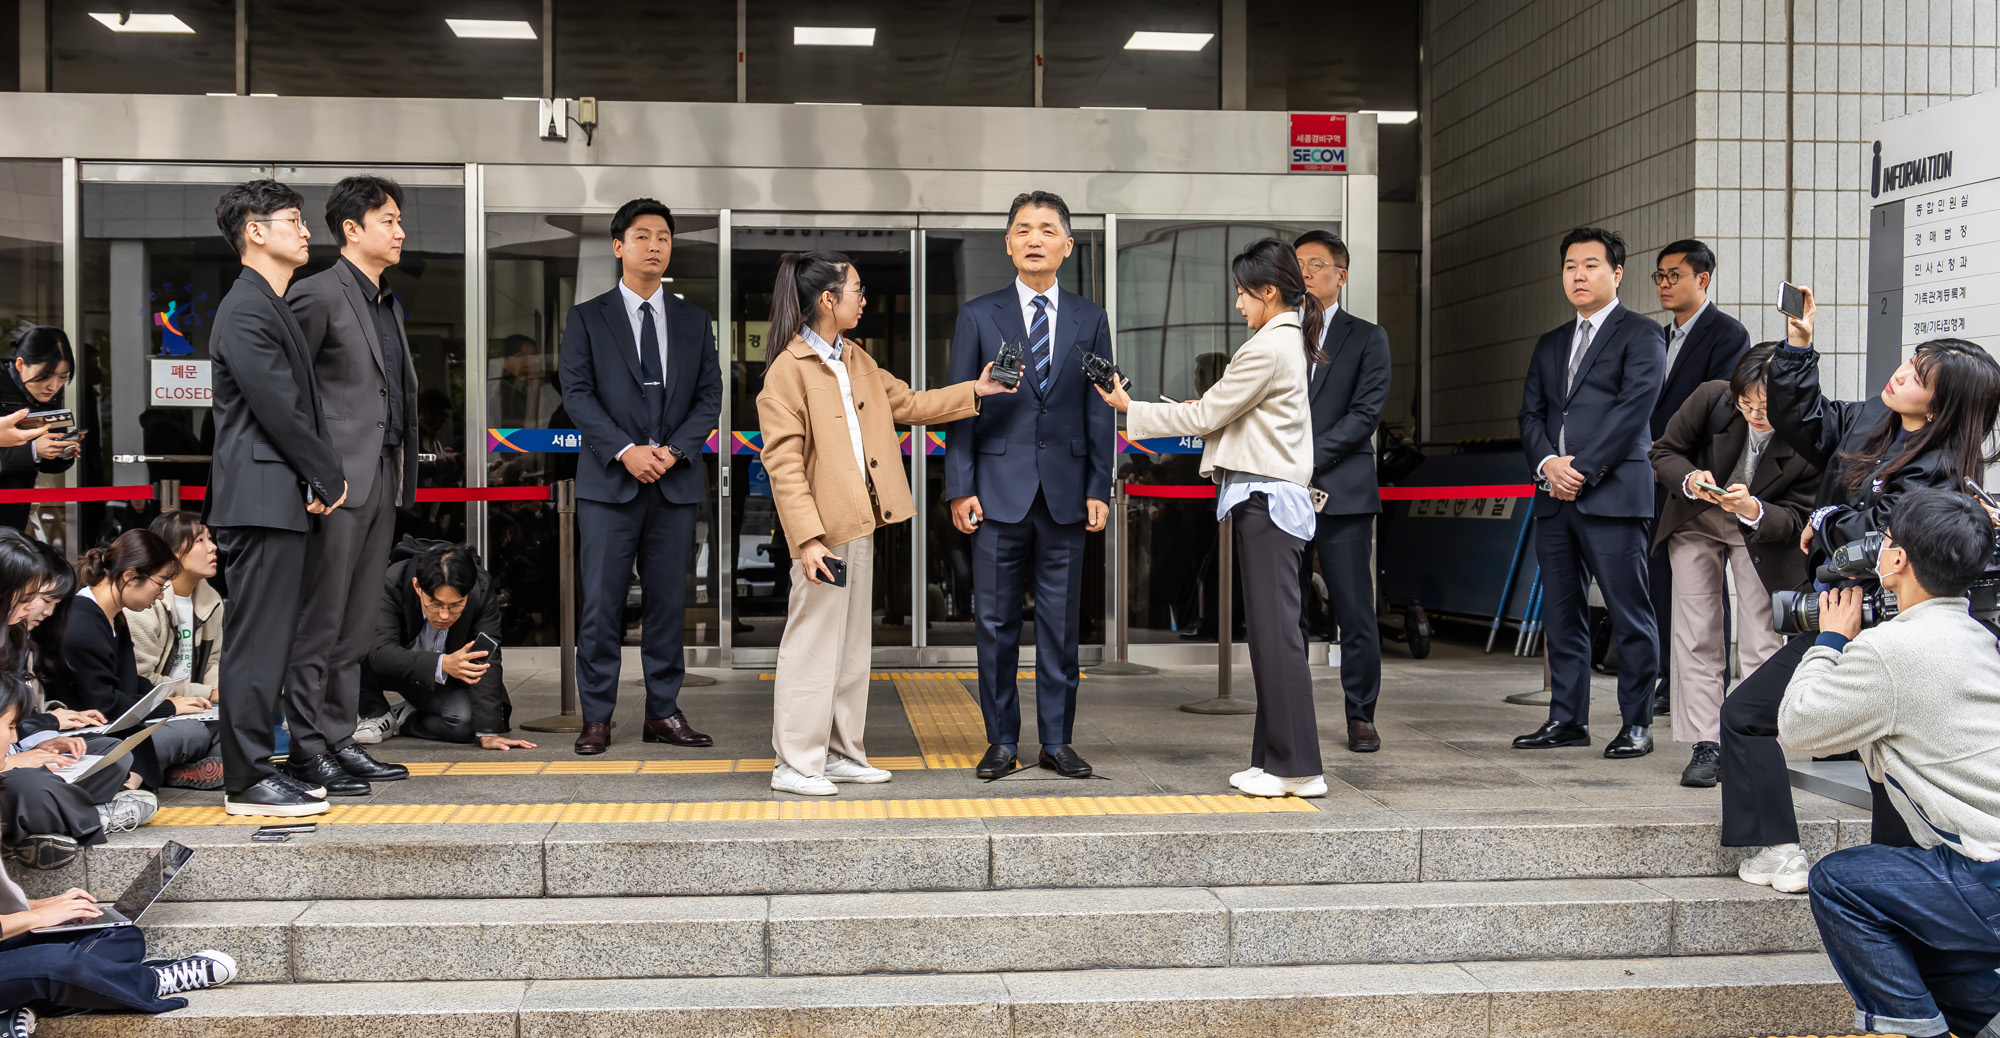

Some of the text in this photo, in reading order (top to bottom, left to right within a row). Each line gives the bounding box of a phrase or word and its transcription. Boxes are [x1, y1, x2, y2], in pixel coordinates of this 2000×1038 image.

[1293, 149, 1344, 163] SECOM
[1882, 151, 1953, 193] INFORMATION
[1881, 210, 1886, 228] 1
[1914, 286, 1967, 306] 가족관계등록계
[1880, 297, 1887, 315] 2
[171, 365, 198, 379] 폐문
[155, 387, 212, 400] CLOSED
[1835, 548, 1849, 568] SBS
